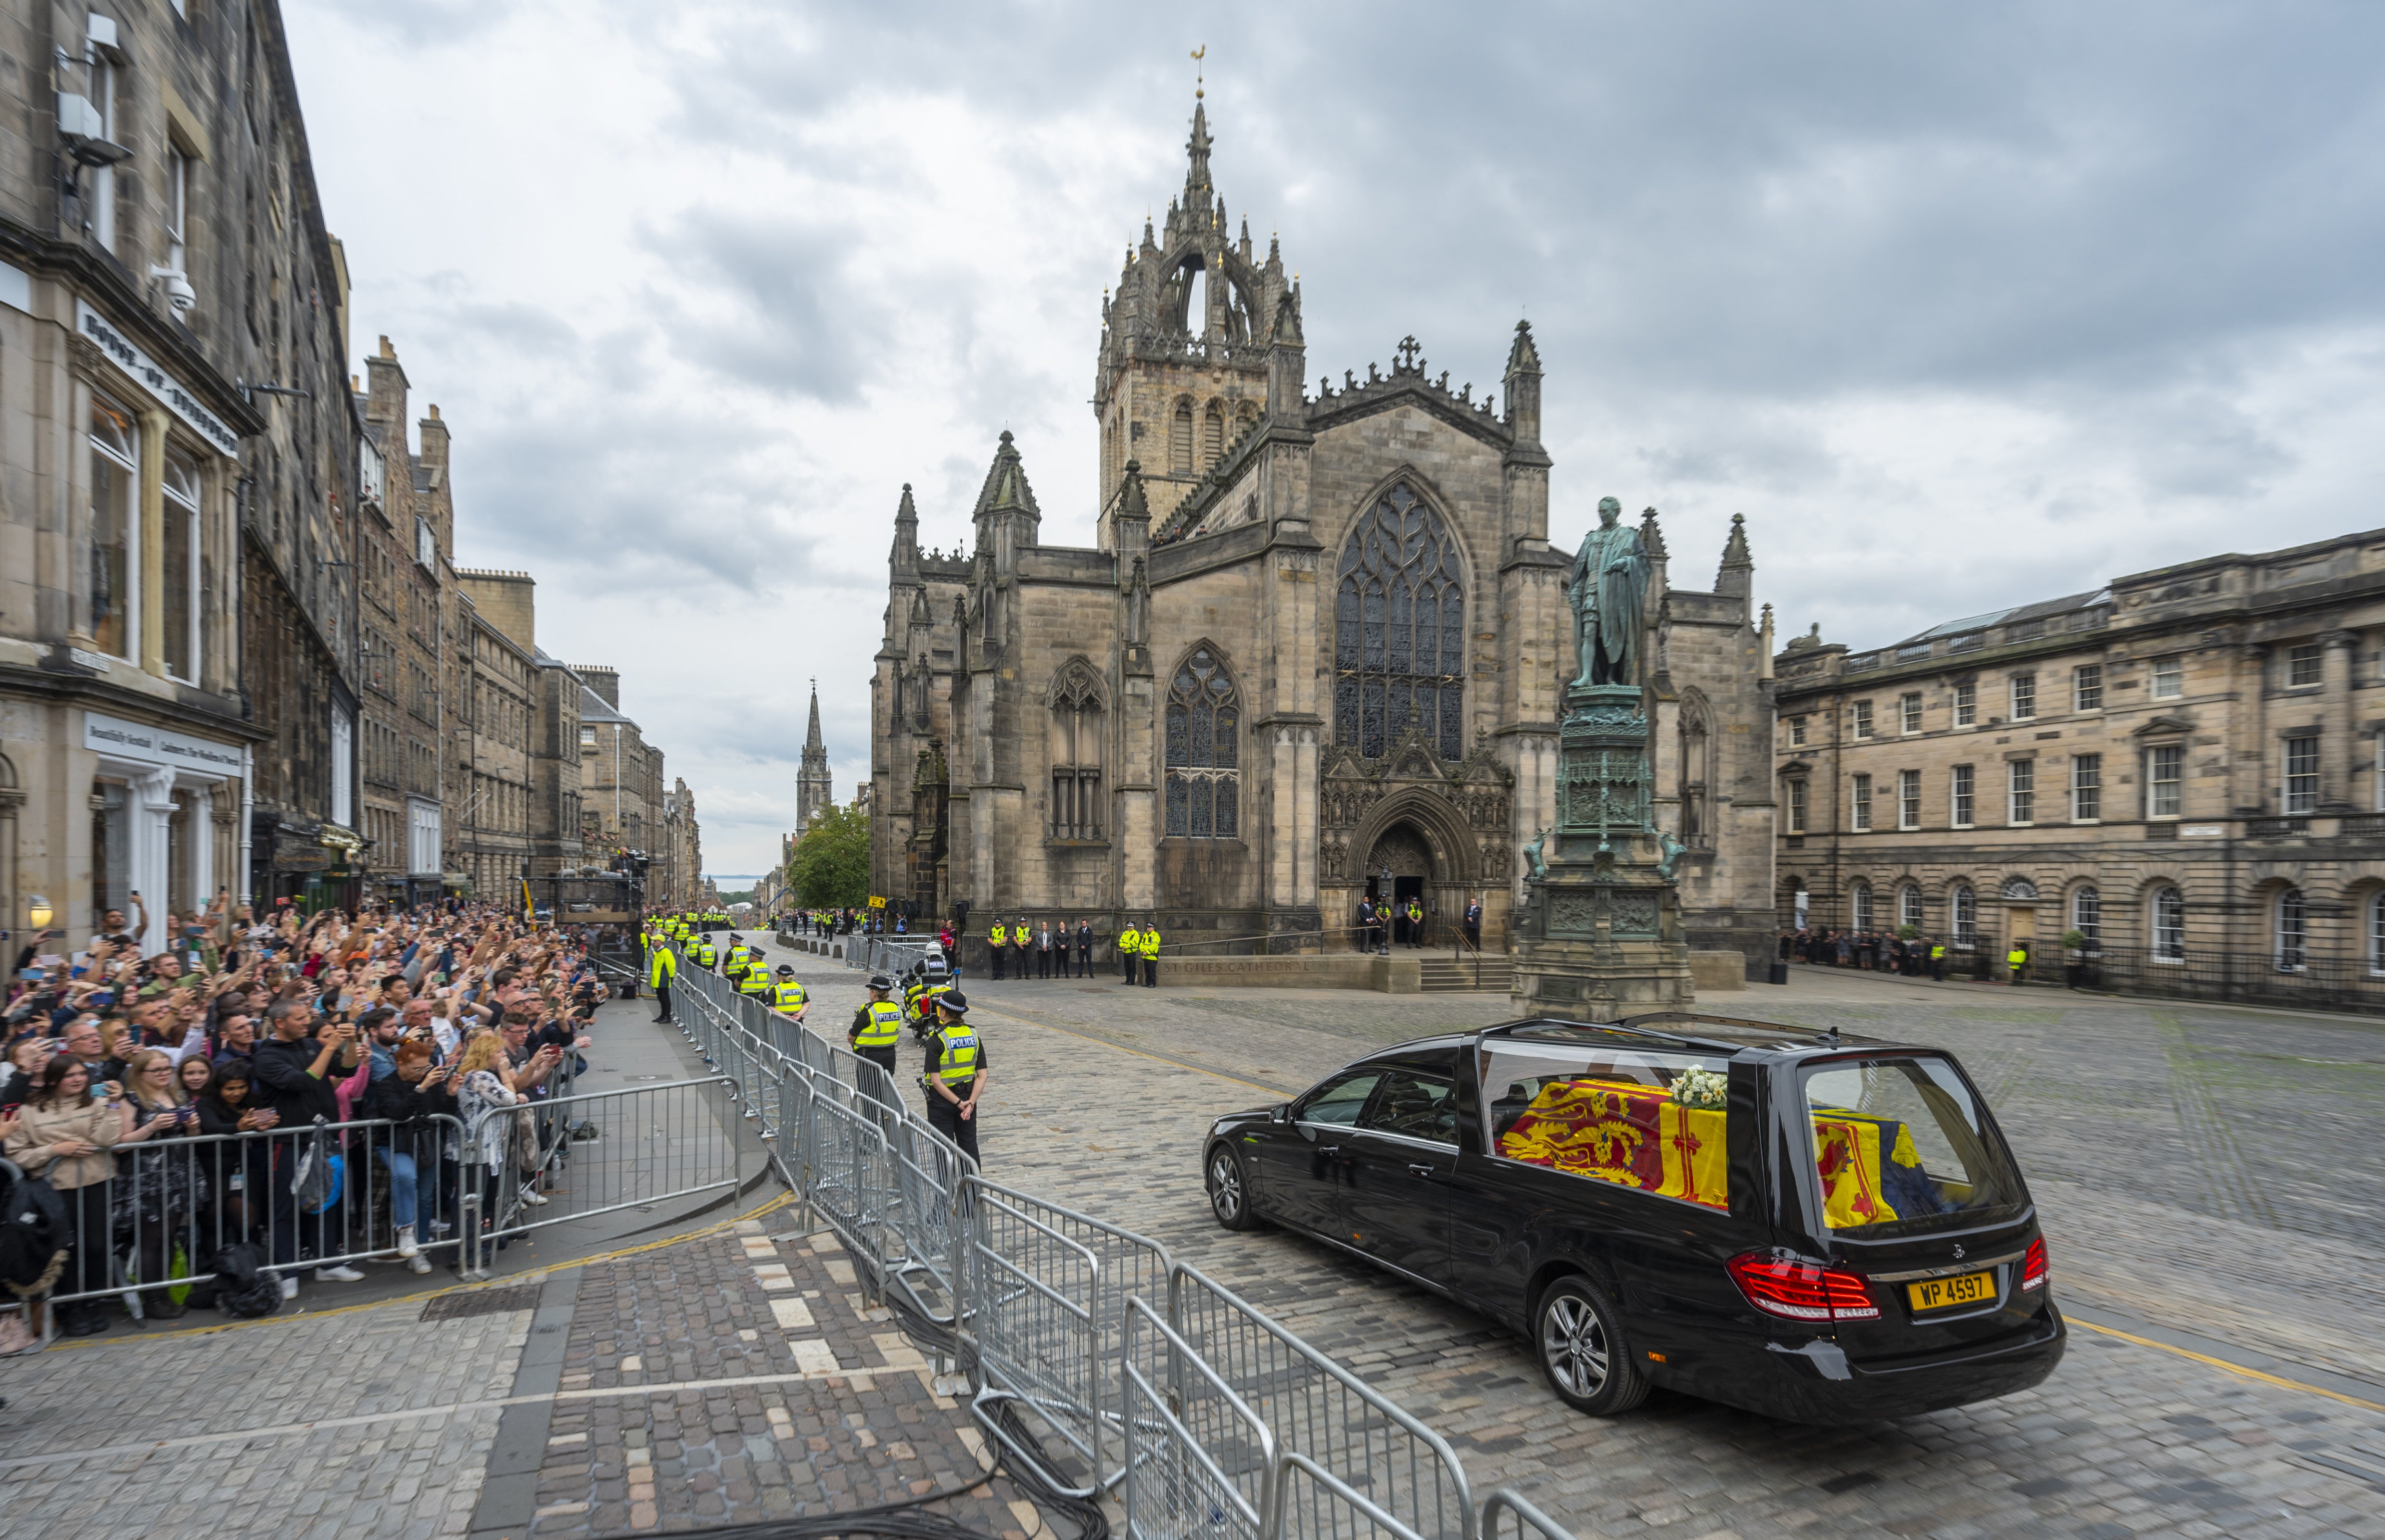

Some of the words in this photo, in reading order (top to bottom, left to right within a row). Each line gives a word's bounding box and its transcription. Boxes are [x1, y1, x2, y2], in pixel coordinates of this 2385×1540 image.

[1165, 963, 1179, 972] ST
[1184, 963, 1221, 972] GILES
[1228, 962, 1309, 972] CATHEDRAL
[879, 1012, 900, 1021] POLICE
[950, 1037, 976, 1048] POLICE
[1920, 1284, 1941, 1306] WP
[1947, 1276, 1982, 1301] 4597
